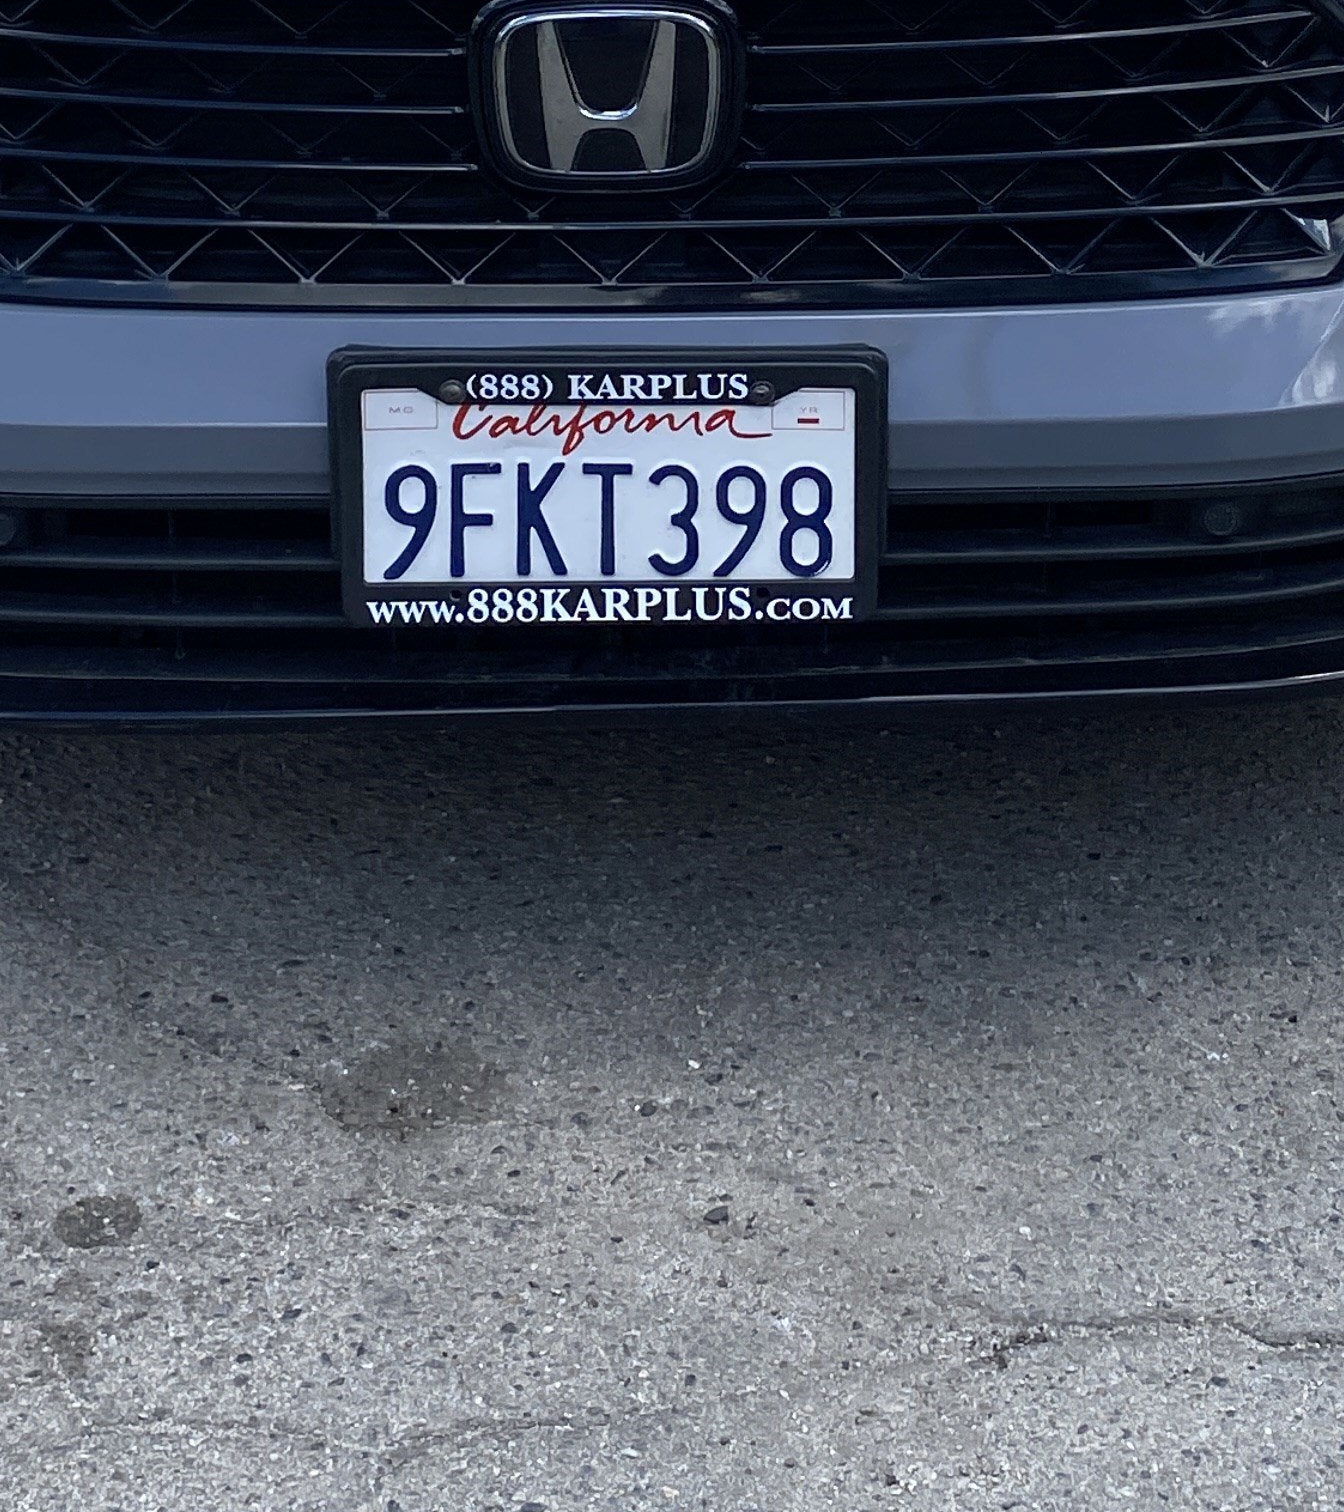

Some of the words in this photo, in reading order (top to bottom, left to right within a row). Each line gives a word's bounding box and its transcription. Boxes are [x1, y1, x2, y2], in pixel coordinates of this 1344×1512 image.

[465, 373, 554, 400] (888)
[567, 373, 749, 401] KARPLUS
[452, 402, 773, 456] California
[383, 461, 834, 580] 9FKT398
